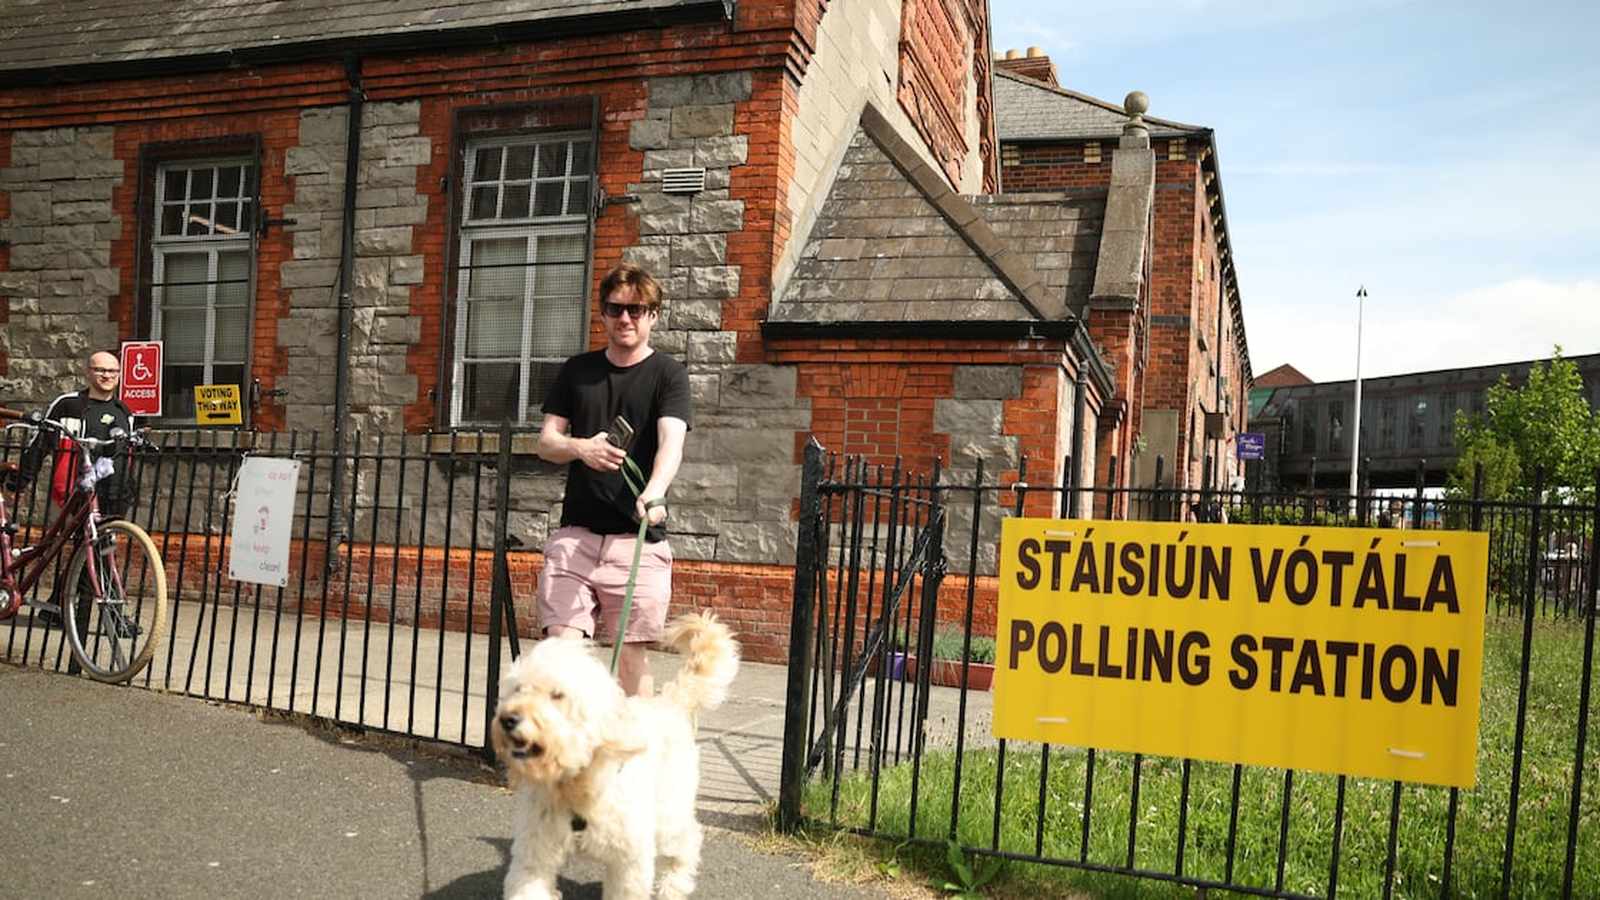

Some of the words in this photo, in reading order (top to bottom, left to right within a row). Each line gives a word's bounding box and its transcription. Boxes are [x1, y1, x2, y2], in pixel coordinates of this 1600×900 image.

[124, 389, 156, 399] ACCESS
[200, 387, 232, 398] VOTING
[198, 401, 216, 411] THIS
[219, 400, 238, 410] WAY
[1016, 528, 1231, 600] STÁISIÚN
[1250, 535, 1460, 613] VÓTÁLA
[1009, 619, 1210, 685] POLLING
[1228, 634, 1460, 706] STATION
